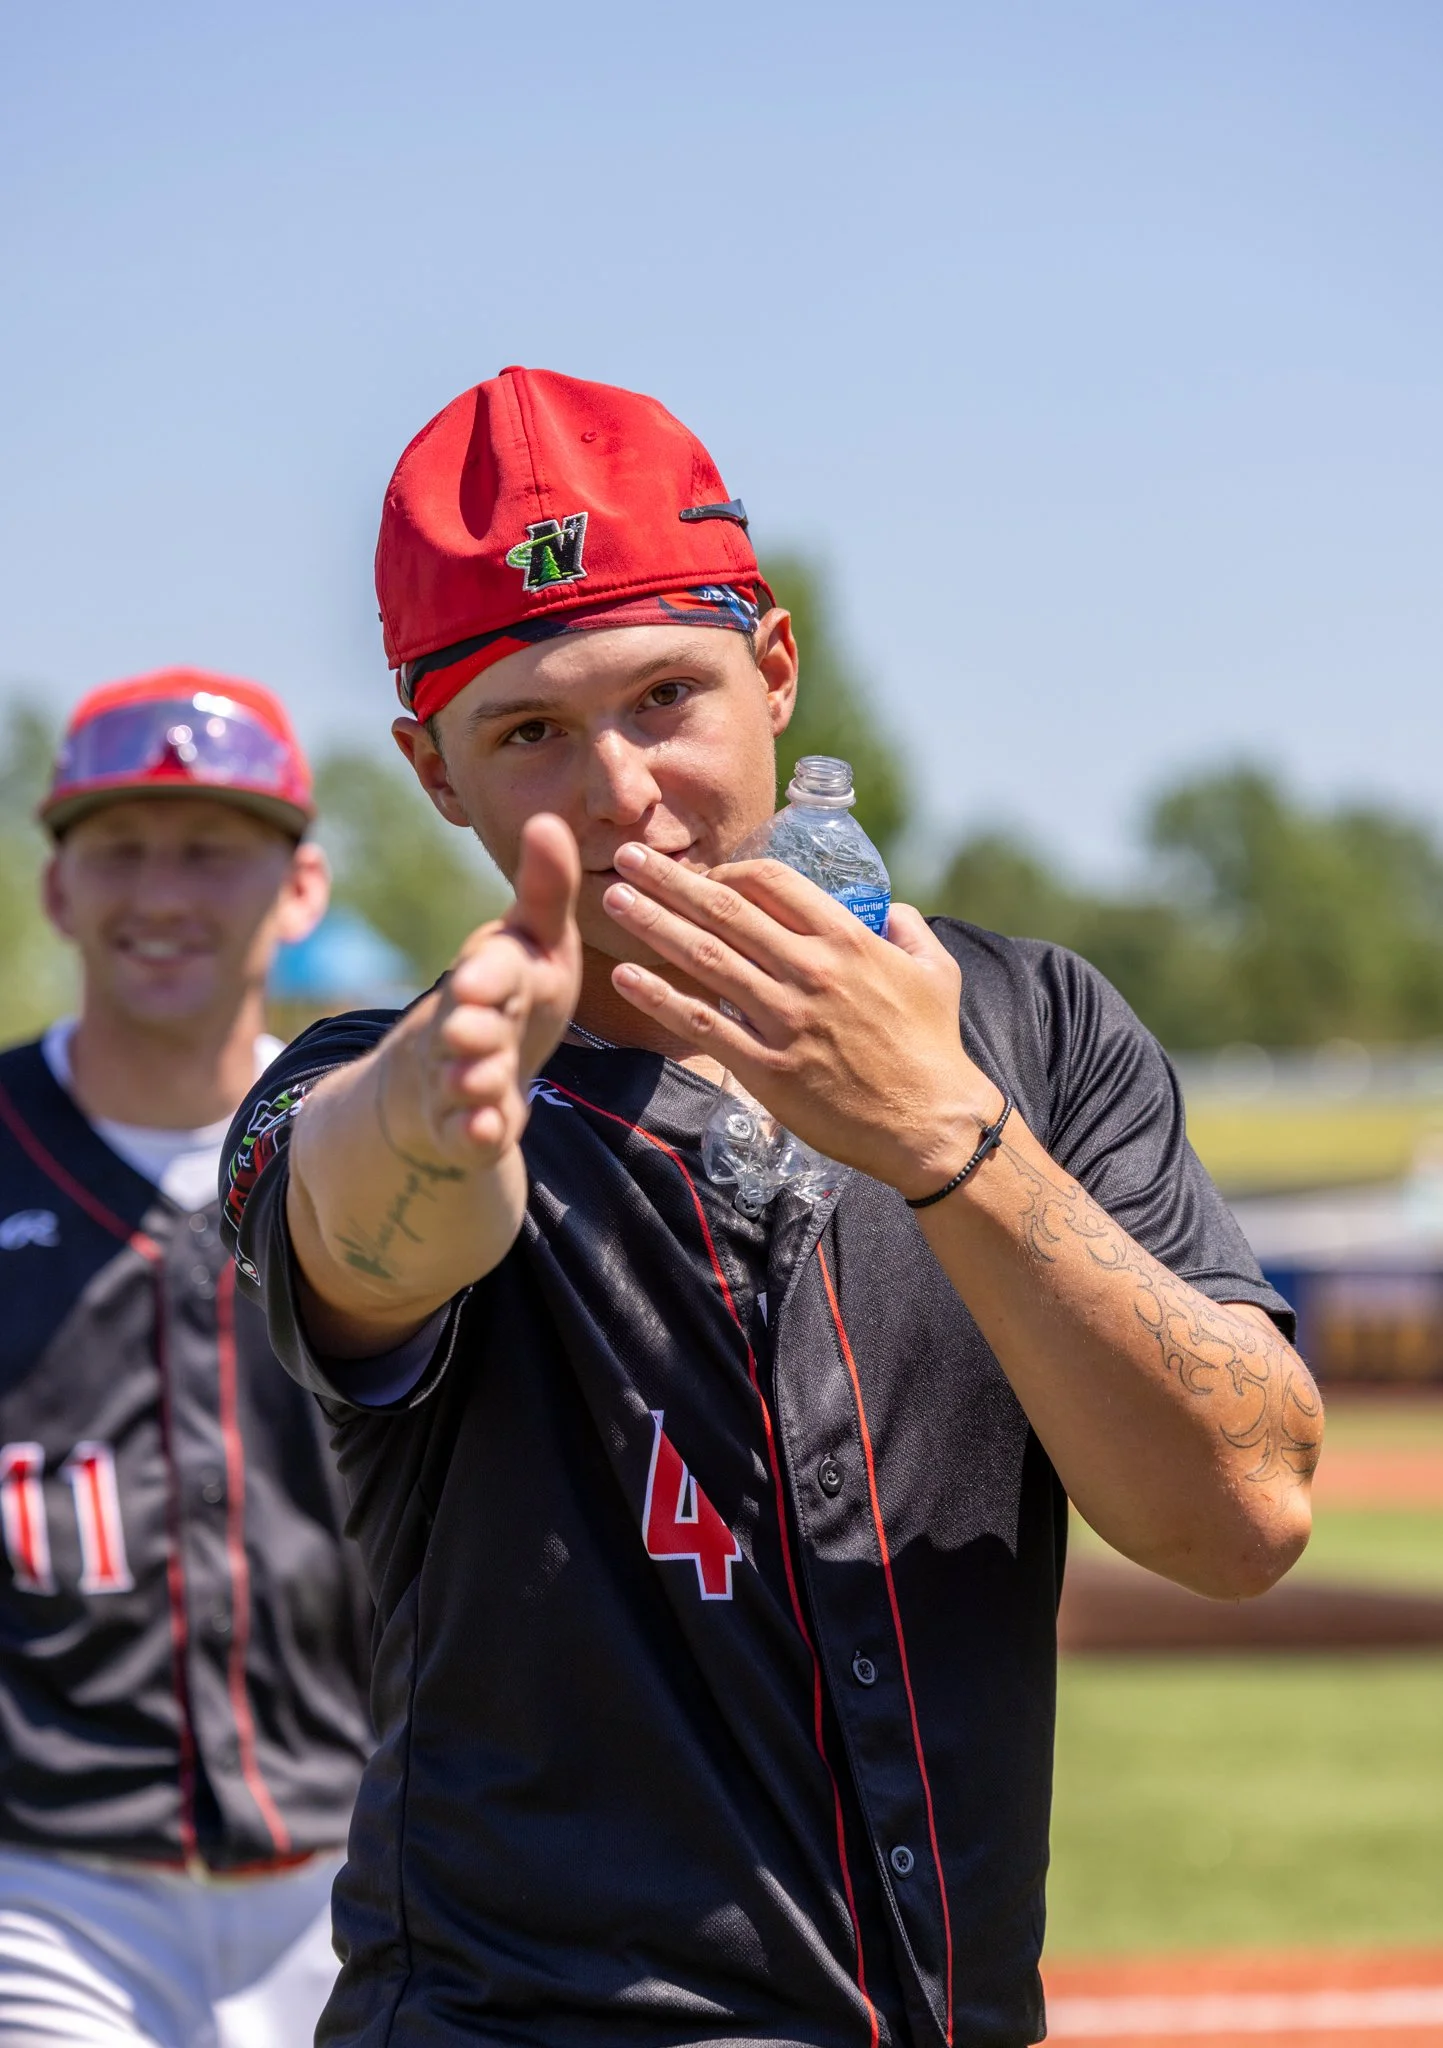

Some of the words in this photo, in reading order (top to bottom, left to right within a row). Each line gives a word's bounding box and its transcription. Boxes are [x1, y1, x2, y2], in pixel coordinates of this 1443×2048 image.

[522, 511, 588, 593] N
[853, 901, 884, 914] Nutrition
[642, 1410, 743, 1601] 4
